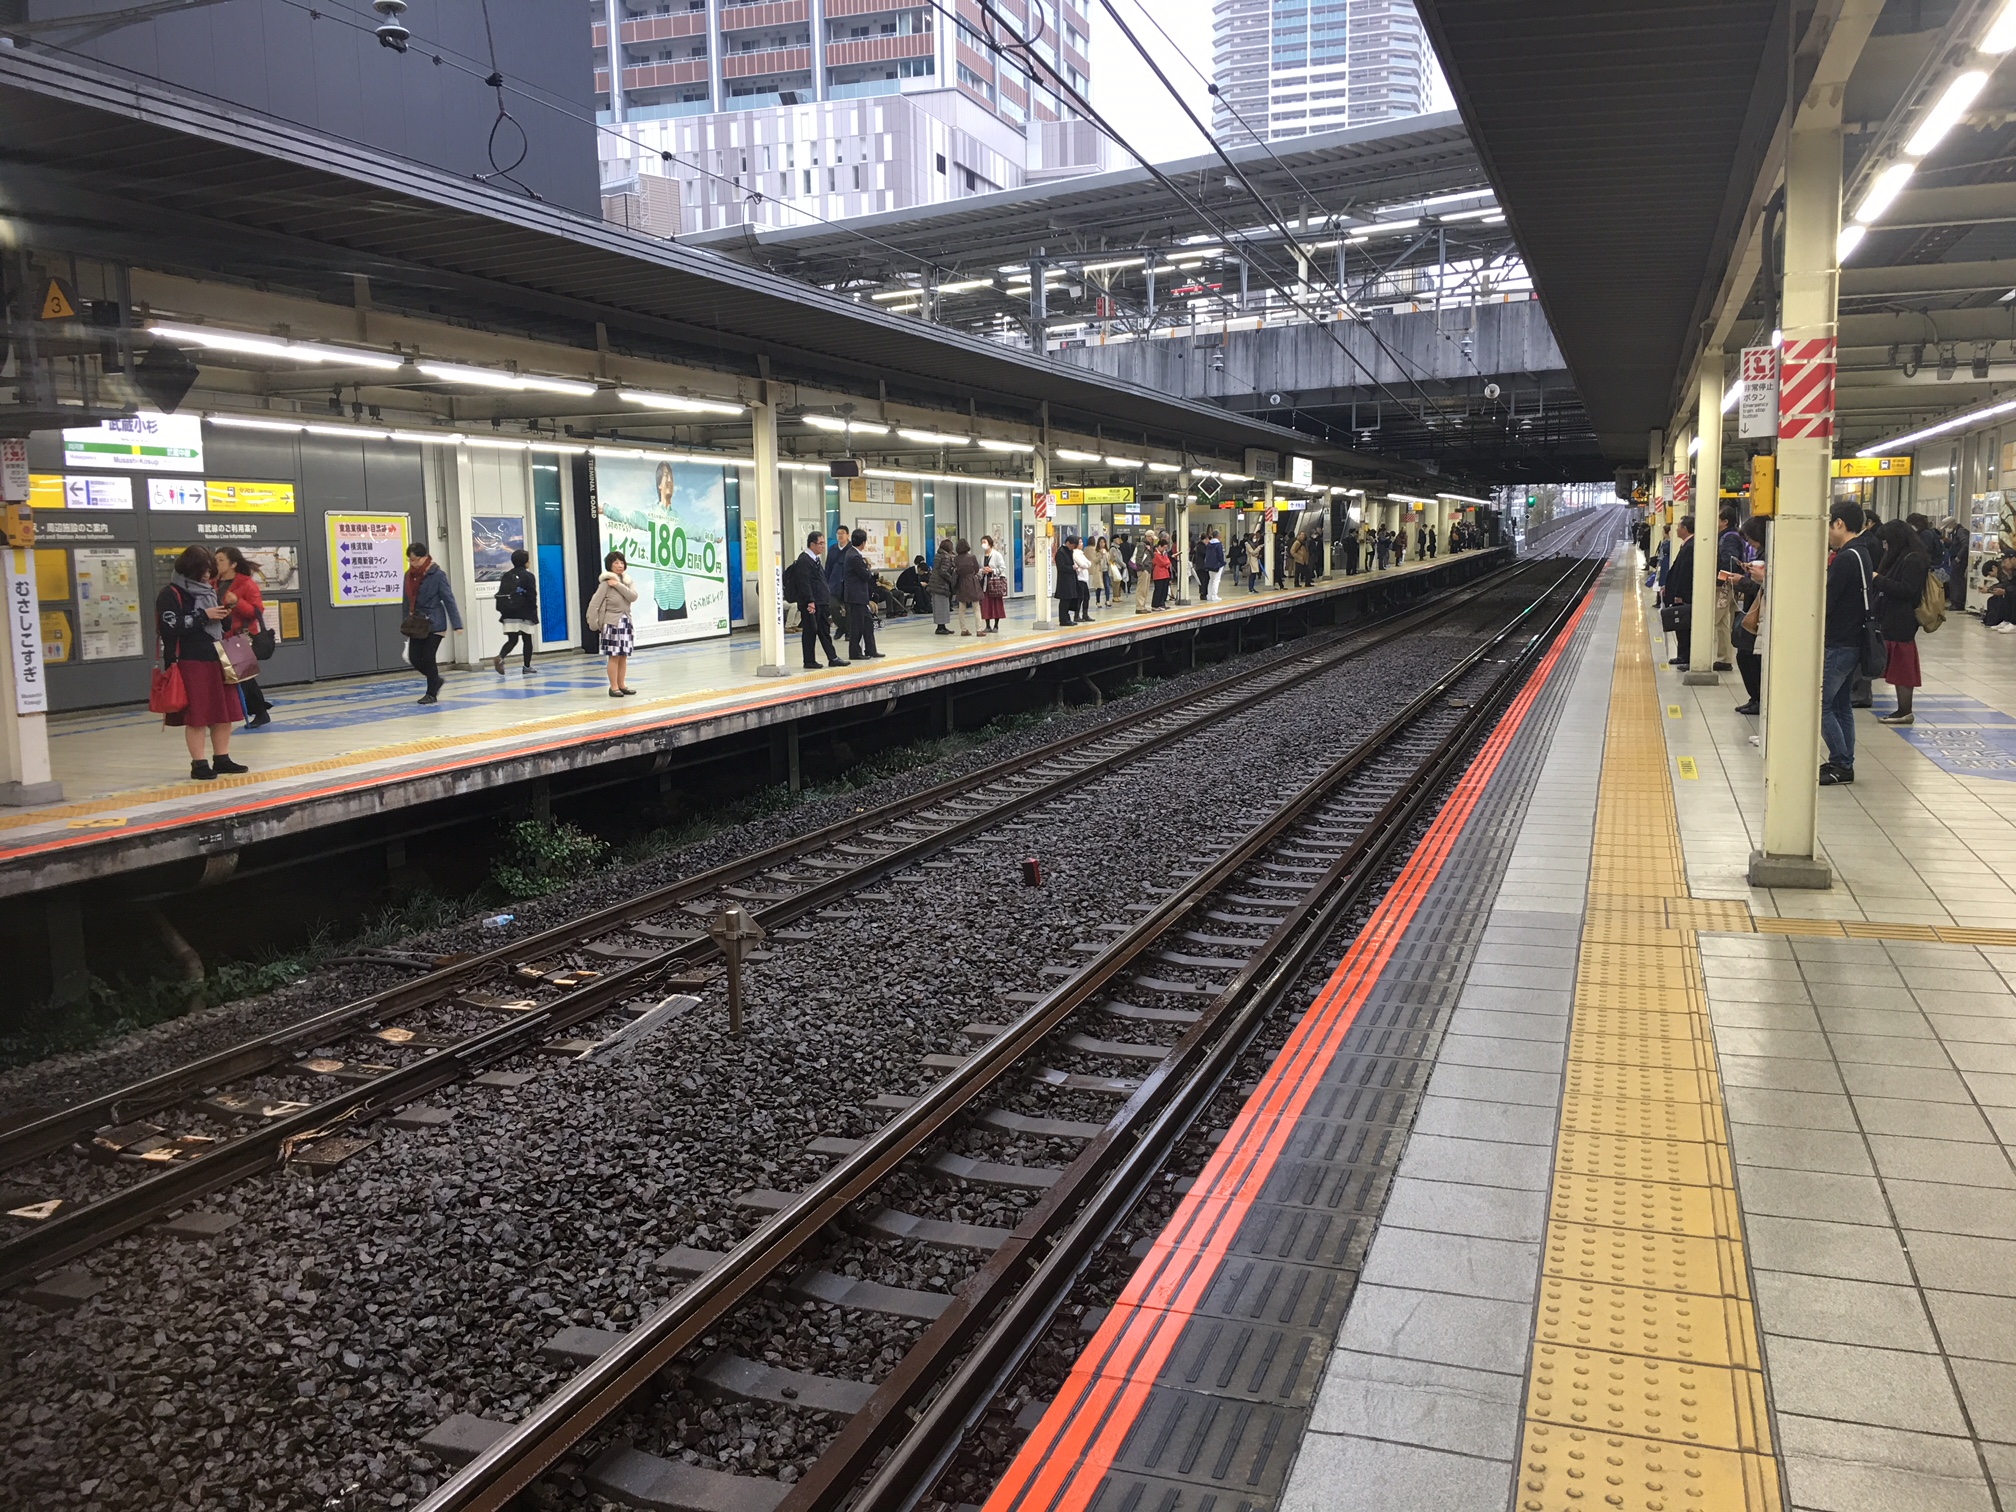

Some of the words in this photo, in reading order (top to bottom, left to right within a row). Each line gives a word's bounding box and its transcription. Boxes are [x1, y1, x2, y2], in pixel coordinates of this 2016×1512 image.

[51, 296, 62, 313] 3
[1744, 383, 1774, 392] 非常停止
[1743, 393, 1766, 402] ボタン
[588, 459, 596, 492] TERMINAL
[1122, 488, 1131, 501] 2
[351, 556, 388, 566] 湘南新宿ライン
[358, 571, 398, 579] 成田エクスプレス
[353, 584, 400, 593] スーパービュー踊り子
[15, 581, 37, 683] むさしこすぎ
